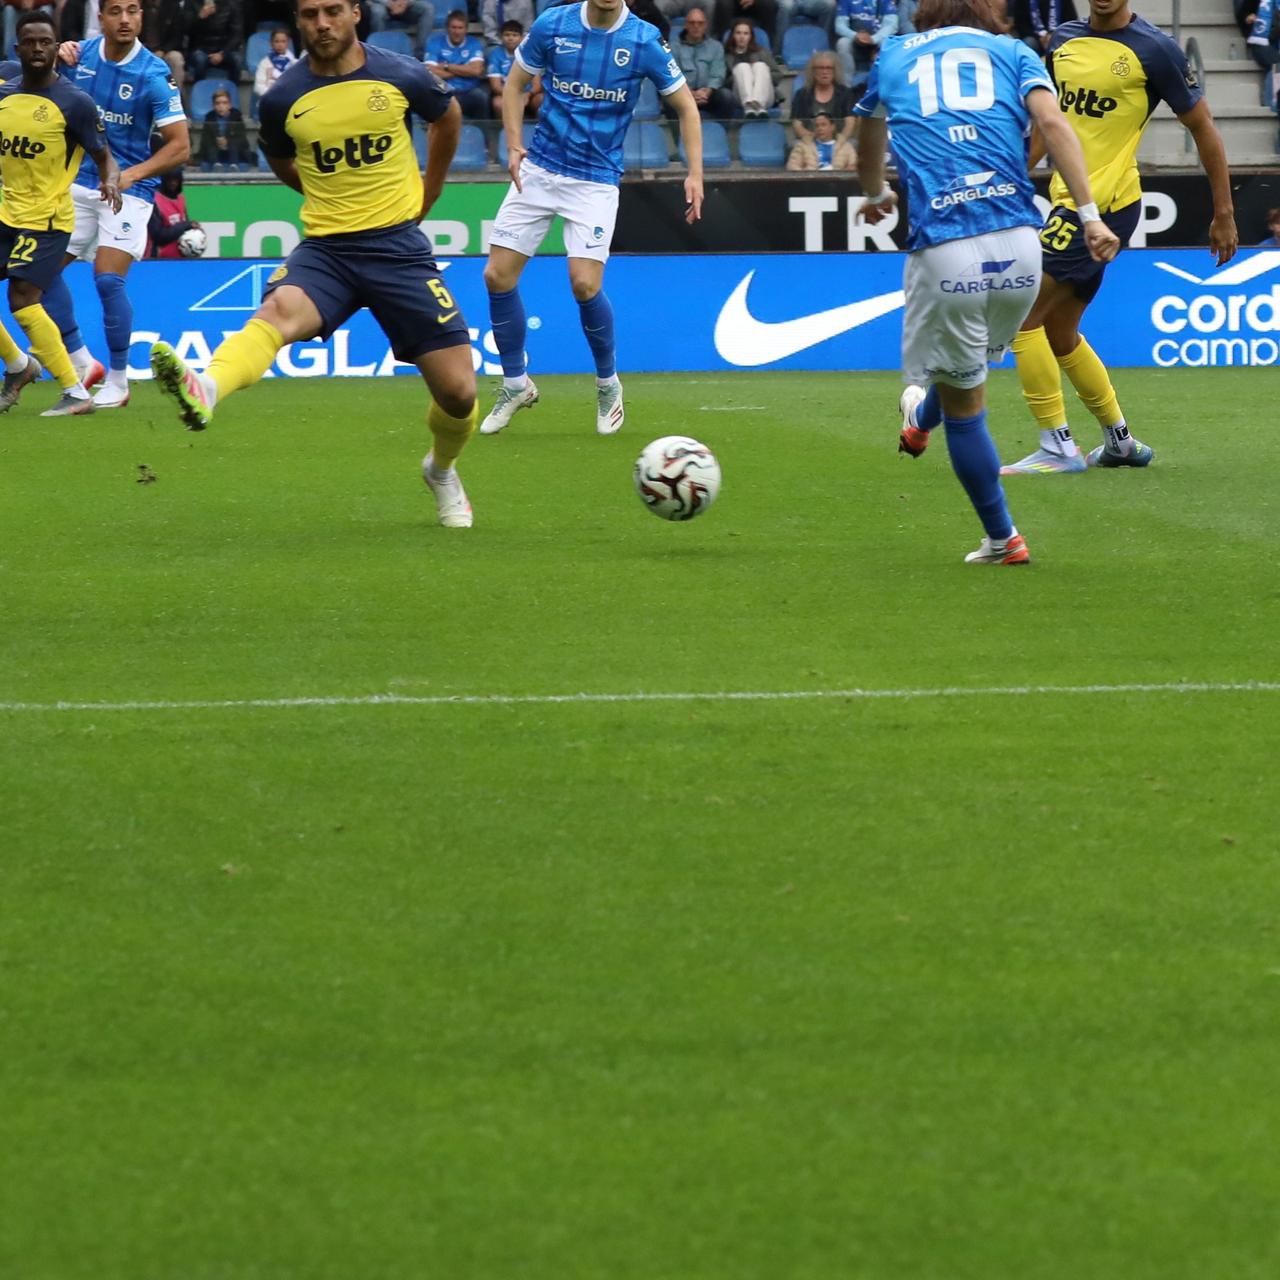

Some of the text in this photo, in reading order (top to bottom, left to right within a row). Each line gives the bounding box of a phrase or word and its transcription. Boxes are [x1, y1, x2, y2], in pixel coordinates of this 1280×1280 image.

[907, 47, 995, 118] 10
[948, 124, 978, 143] ITO
[930, 183, 1017, 210] CARGLASS
[1039, 215, 1078, 251] 25
[9, 234, 38, 263] 22
[425, 278, 454, 309] 5
[940, 274, 1036, 294] CARGLASS
